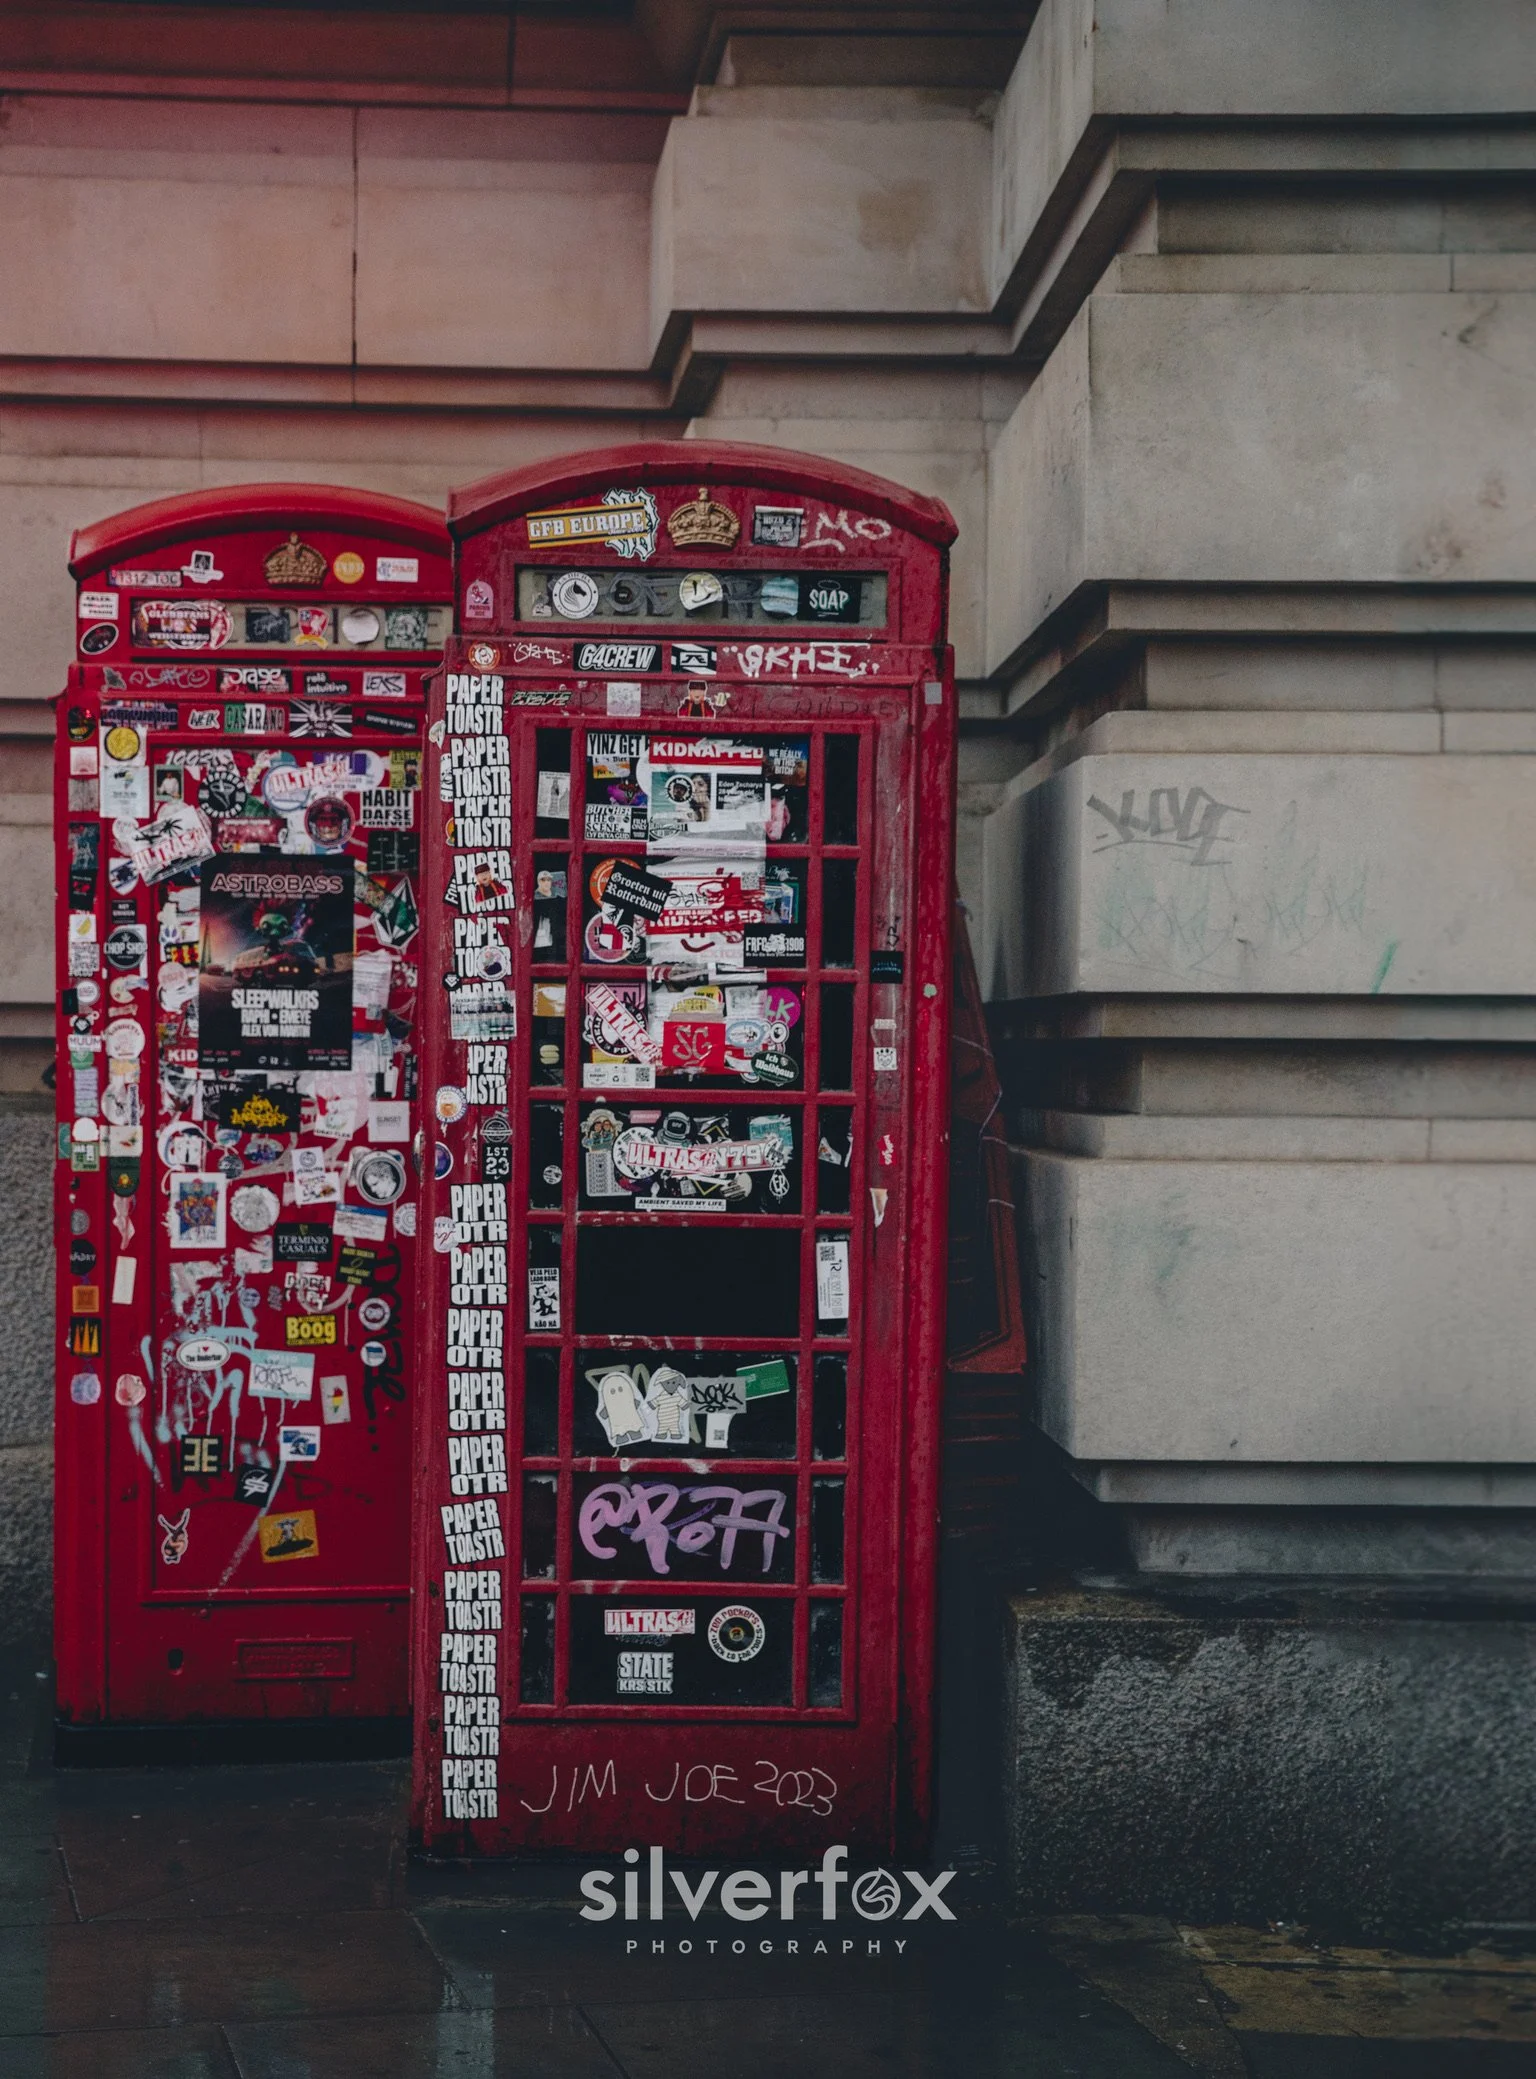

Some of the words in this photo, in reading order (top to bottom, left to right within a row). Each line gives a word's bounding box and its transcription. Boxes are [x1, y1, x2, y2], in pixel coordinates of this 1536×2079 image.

[529, 518, 565, 538] GFB
[570, 511, 644, 534] EUROPE
[809, 588, 849, 610] SOAP
[580, 645, 656, 670] 64CREW
[446, 674, 504, 704] PAPER
[225, 705, 285, 735] CASARANO
[446, 704, 502, 734] TOASTR
[451, 736, 509, 767] PAPER
[588, 734, 617, 756] YINZ
[620, 735, 642, 757] GET
[453, 766, 511, 798] TOASTR
[774, 766, 794, 775] BITCH
[362, 790, 411, 806] HABIT
[586, 805, 631, 816] BUTCHER
[362, 808, 412, 820] DAFSE
[586, 815, 608, 823] THE
[454, 817, 511, 847] TOASTR
[210, 873, 344, 894] ASTROBASS
[610, 871, 652, 897] Groeten
[652, 888, 668, 902] uit
[605, 881, 663, 915] Rotterdam
[104, 942, 125, 954] CHOP
[126, 942, 148, 954] SHOP
[231, 988, 320, 1010] SLEEPWALKRS
[279, 1010, 312, 1024] EMEYE
[242, 1025, 262, 1037] ALEX
[168, 1049, 199, 1062] KID
[766, 1053, 778, 1064] Ich
[486, 1147, 509, 1156] LST
[629, 1143, 701, 1172] ULTRAS
[485, 1157, 510, 1175] 23
[451, 1183, 507, 1221] PAPER
[455, 1220, 508, 1243] OTR
[278, 1244, 328, 1254] CASUALS
[451, 1247, 507, 1284] PAPER
[451, 1284, 508, 1305] OTR
[287, 1317, 337, 1344] Boog
[447, 1309, 504, 1347] PAPER
[447, 1345, 503, 1368] OTR
[448, 1372, 505, 1409] PAPER
[449, 1409, 506, 1430] OTR
[448, 1434, 506, 1475] PAPER
[451, 1472, 508, 1496] OTR
[440, 1498, 500, 1535] PAPER
[445, 1528, 506, 1564] TOASTR
[444, 1570, 501, 1600] PAPER
[445, 1600, 502, 1631] TOASTR
[606, 1611, 680, 1634] ULTRAS
[722, 1607, 761, 1627] rockers
[441, 1633, 498, 1664] PAPER
[710, 1637, 726, 1660] back
[725, 1651, 736, 1660] to
[737, 1648, 752, 1661] the
[751, 1628, 765, 1655] roots
[440, 1663, 497, 1693] TOASTR
[618, 1652, 674, 1679] STATE
[645, 1679, 673, 1693] STK
[444, 1695, 500, 1726] PAPER
[444, 1725, 500, 1755] TOASTR
[442, 1759, 498, 1789] PAPER
[521, 1760, 616, 1812] JIM
[646, 1762, 746, 1803] JOE
[754, 1761, 837, 1816] 2023
[443, 1789, 498, 1819] TOASTR
